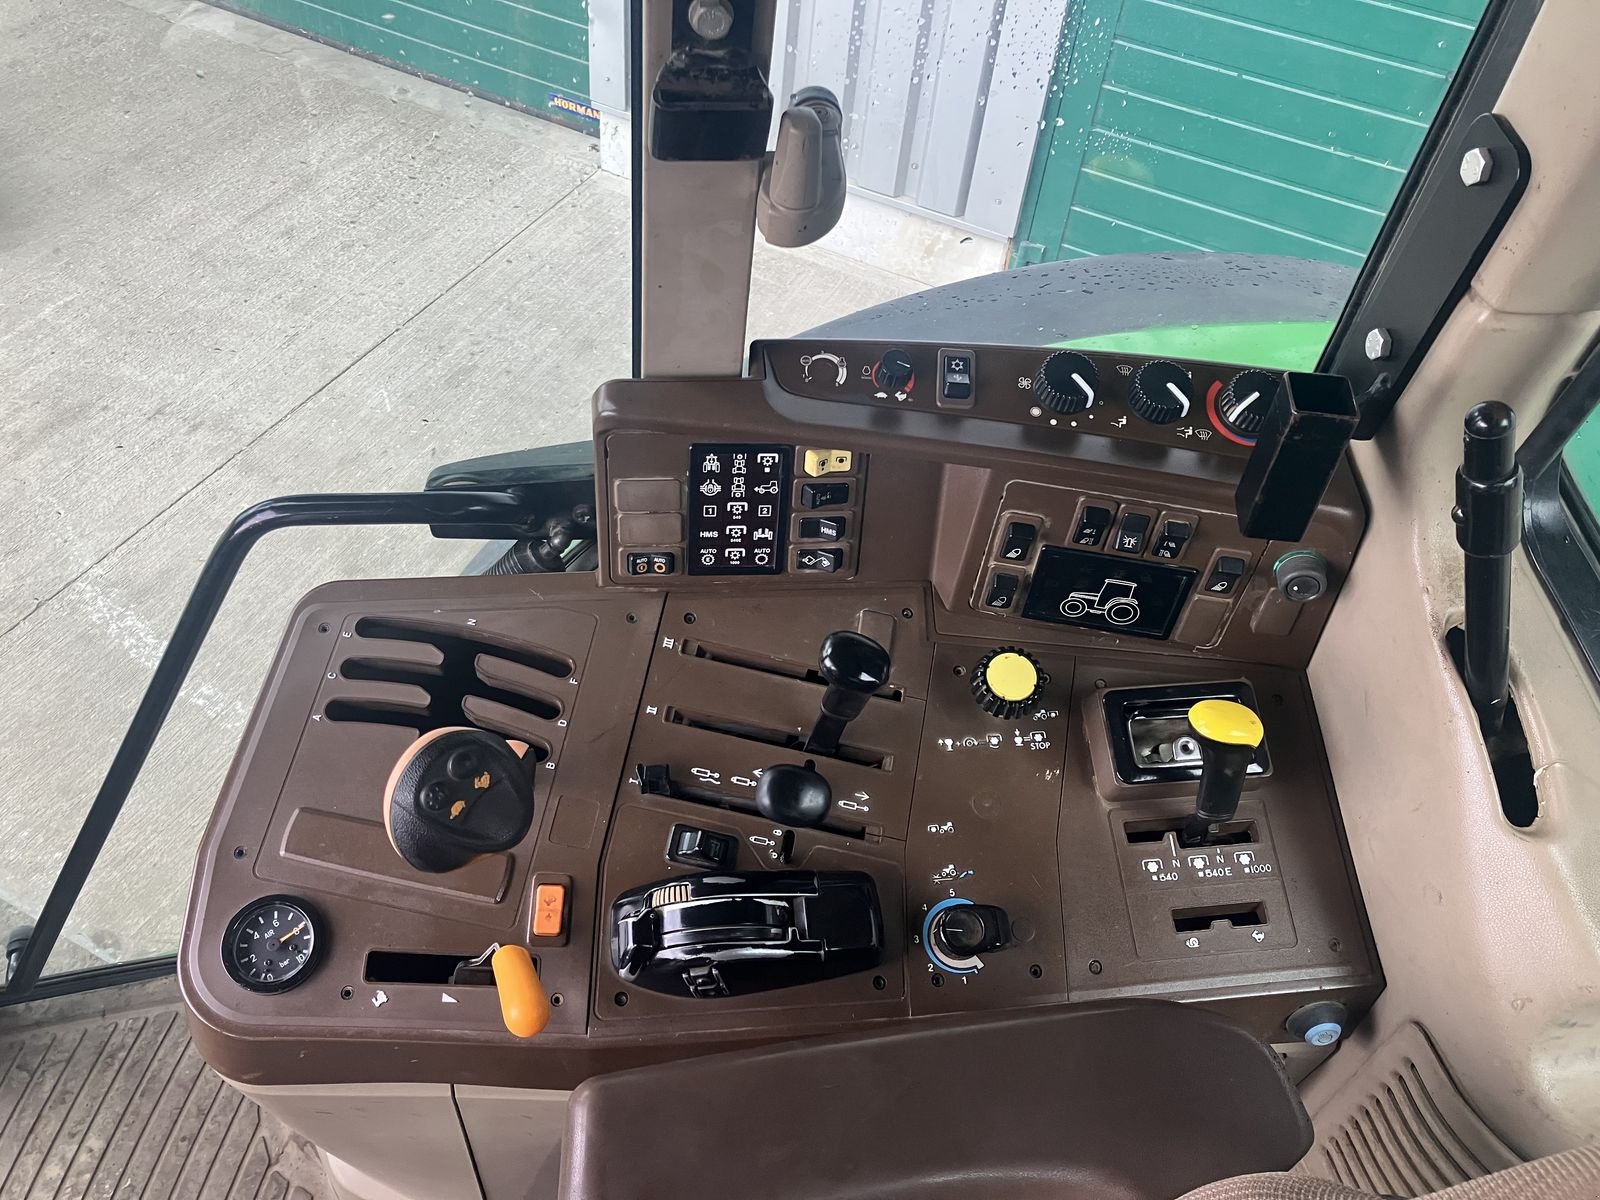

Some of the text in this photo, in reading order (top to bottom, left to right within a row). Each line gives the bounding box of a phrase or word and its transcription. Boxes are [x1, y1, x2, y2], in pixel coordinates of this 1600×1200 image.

[820, 526, 837, 537] HMS
[467, 618, 477, 626] N
[327, 672, 338, 680] C
[569, 677, 580, 685] F
[312, 714, 322, 722] A
[557, 719, 568, 728] D
[1030, 741, 1051, 750] STOP
[545, 761, 556, 770] B
[1172, 859, 1181, 868] N
[1216, 855, 1225, 864] N
[1251, 863, 1272, 874] 1000
[1159, 872, 1179, 882] 540
[949, 888, 956, 897] 5
[921, 903, 928, 911] 4
[272, 919, 280, 928] 6
[253, 931, 260, 940] 4
[264, 928, 276, 940] AIR
[914, 935, 920, 944] 3
[249, 954, 258, 963] 2
[278, 958, 291, 968] bar
[295, 953, 305, 964] 10
[927, 963, 934, 973] 2
[266, 973, 274, 982] 0
[961, 976, 968, 985] 1
